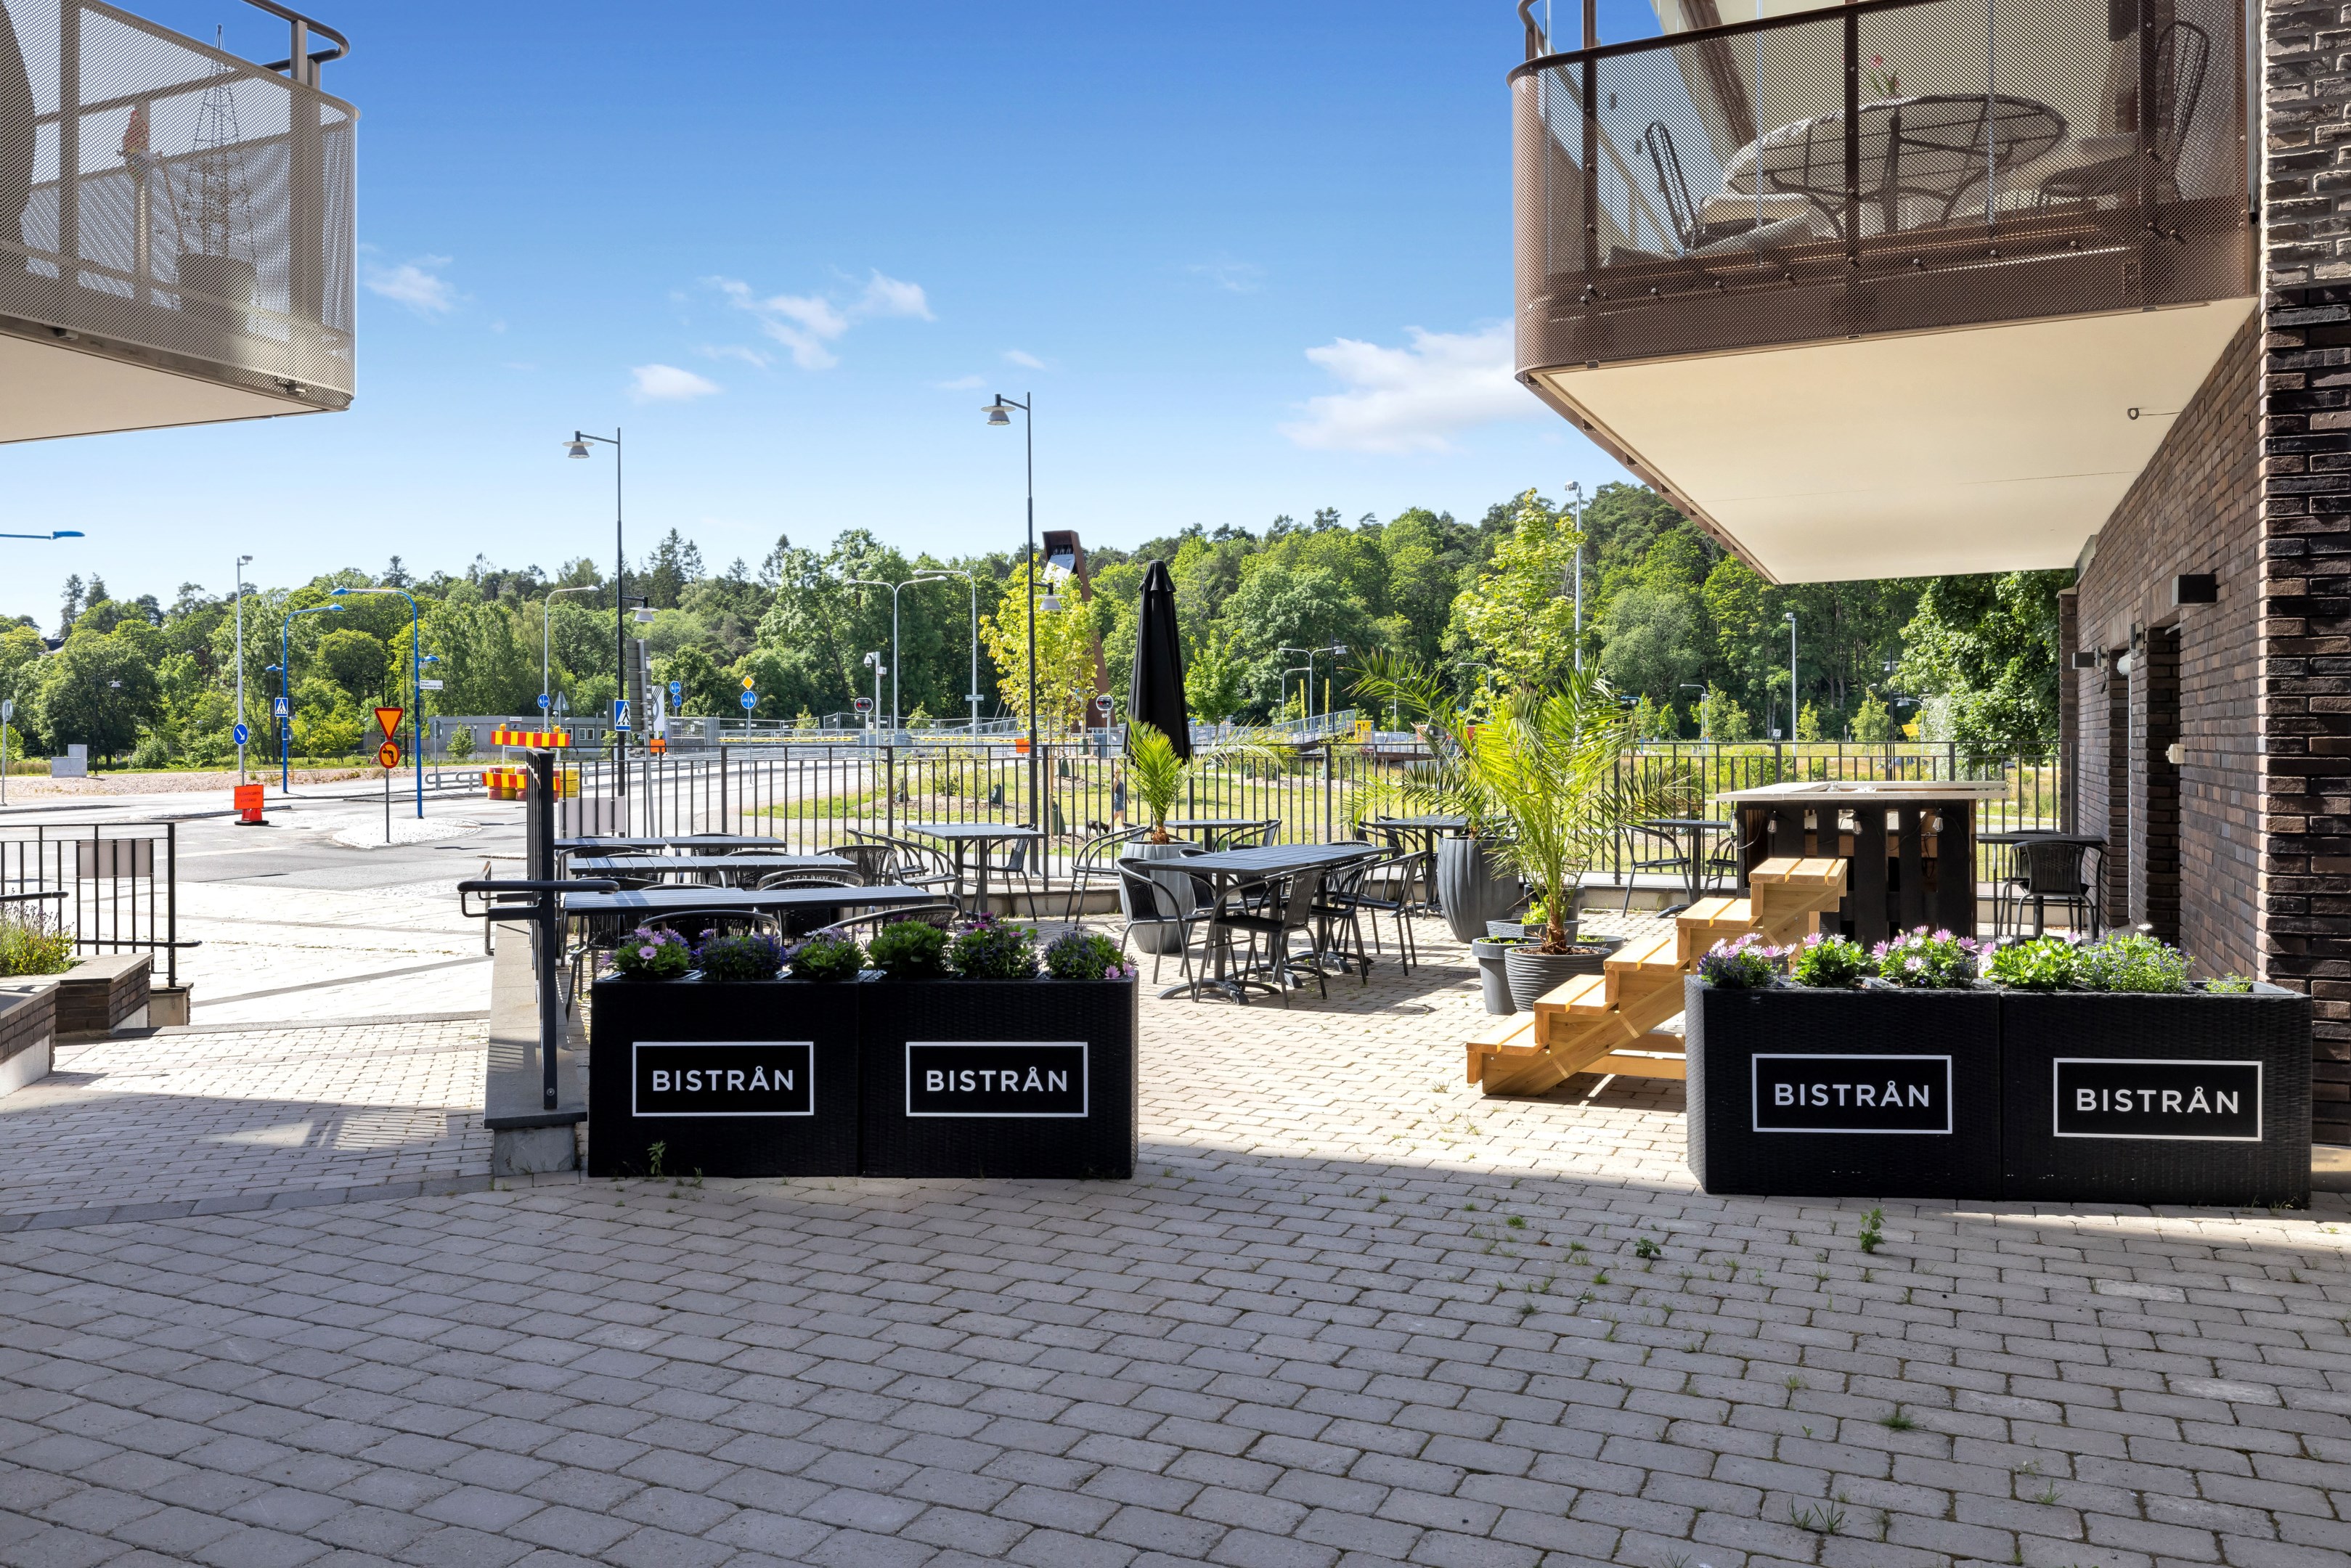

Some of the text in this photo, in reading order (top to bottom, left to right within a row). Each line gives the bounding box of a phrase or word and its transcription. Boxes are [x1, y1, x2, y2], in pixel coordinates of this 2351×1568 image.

[653, 1066, 793, 1091] BISTRÅN
[926, 1066, 1067, 1092] BISTRÅN
[1775, 1080, 1929, 1107] BISTRÅN
[2077, 1086, 2239, 1114] BISTRÅN
